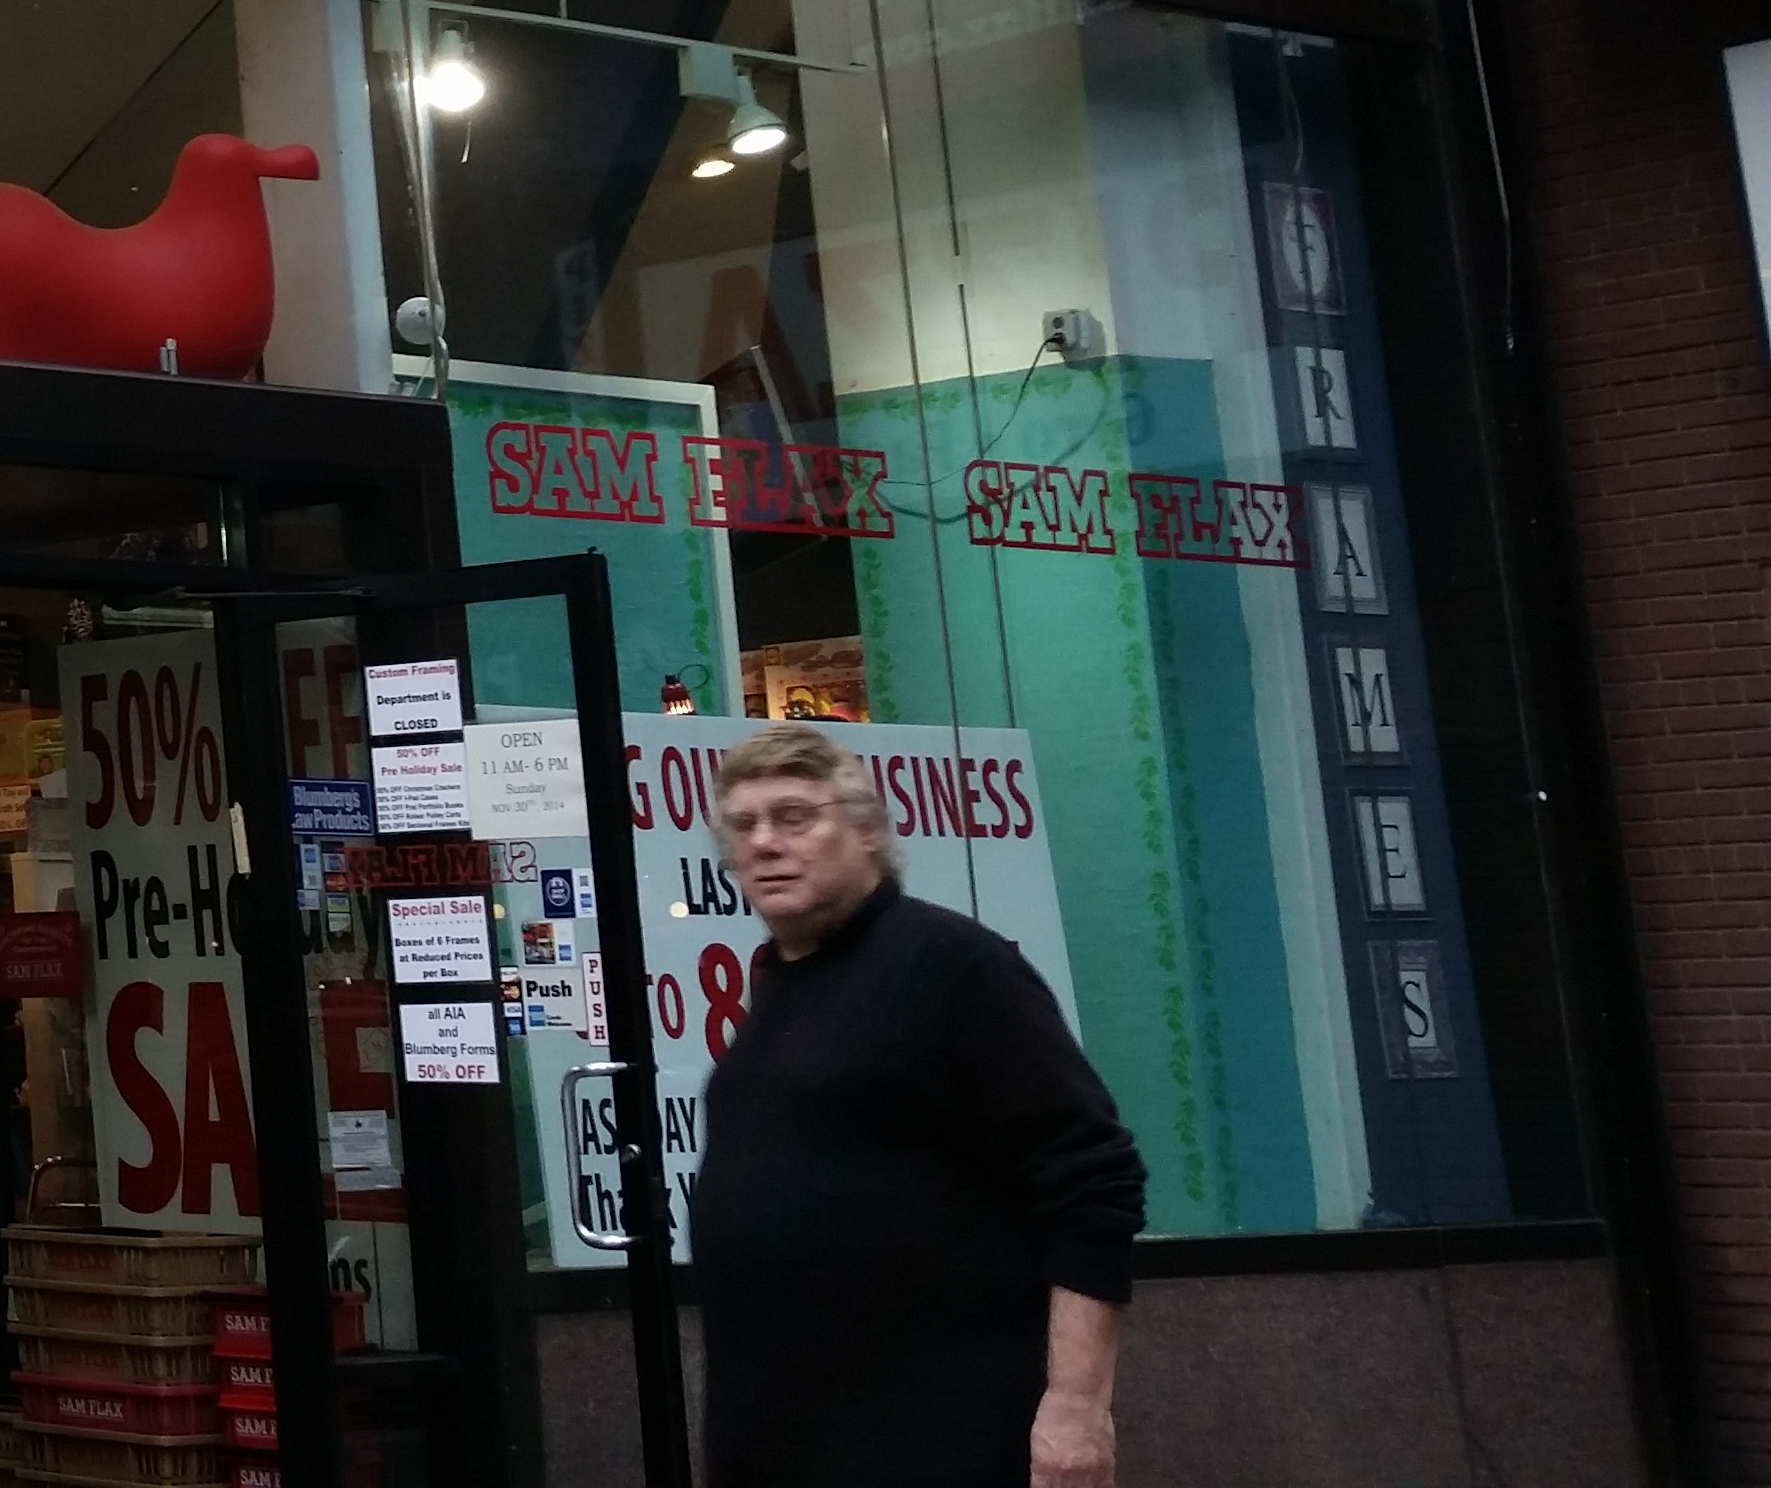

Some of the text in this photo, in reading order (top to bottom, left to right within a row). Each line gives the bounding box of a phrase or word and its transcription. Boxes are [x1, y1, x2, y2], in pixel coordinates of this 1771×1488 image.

[485, 421, 896, 539] SAM FLAX
[963, 458, 1312, 568] SAM FLAX
[368, 663, 456, 680] Custom Framing
[376, 691, 451, 706] Department is
[394, 718, 438, 731] CLOSED
[80, 661, 222, 831] 50%
[500, 731, 544, 749] OPEN
[396, 746, 440, 759] 50% OFF
[381, 763, 463, 777] Pre Holiday Sale
[481, 760, 498, 776] 11
[534, 756, 544, 772] 6
[548, 757, 569, 772] PM
[505, 782, 547, 796] Sunday
[661, 746, 721, 832] OU
[292, 810, 313, 829] aw
[680, 856, 752, 916] LAS
[391, 899, 482, 919] Special Sale
[395, 935, 423, 947] Boxes
[425, 935, 435, 946] of
[445, 934, 480, 945] Frames
[399, 950, 484, 963] at Reduced Prices
[422, 967, 459, 980] per Box
[525, 979, 573, 998] Push
[588, 959, 606, 1040] PUSH
[428, 1008, 441, 1020] all
[438, 1026, 459, 1038] and
[405, 1042, 496, 1058] Blumberg Forms
[417, 1064, 486, 1079] 50% OFF
[665, 1096, 697, 1153] AY
[225, 1315, 257, 1332] SAM
[230, 1366, 262, 1384] SAM
[58, 1396, 87, 1416] SAM
[235, 1417, 267, 1436] SAM
